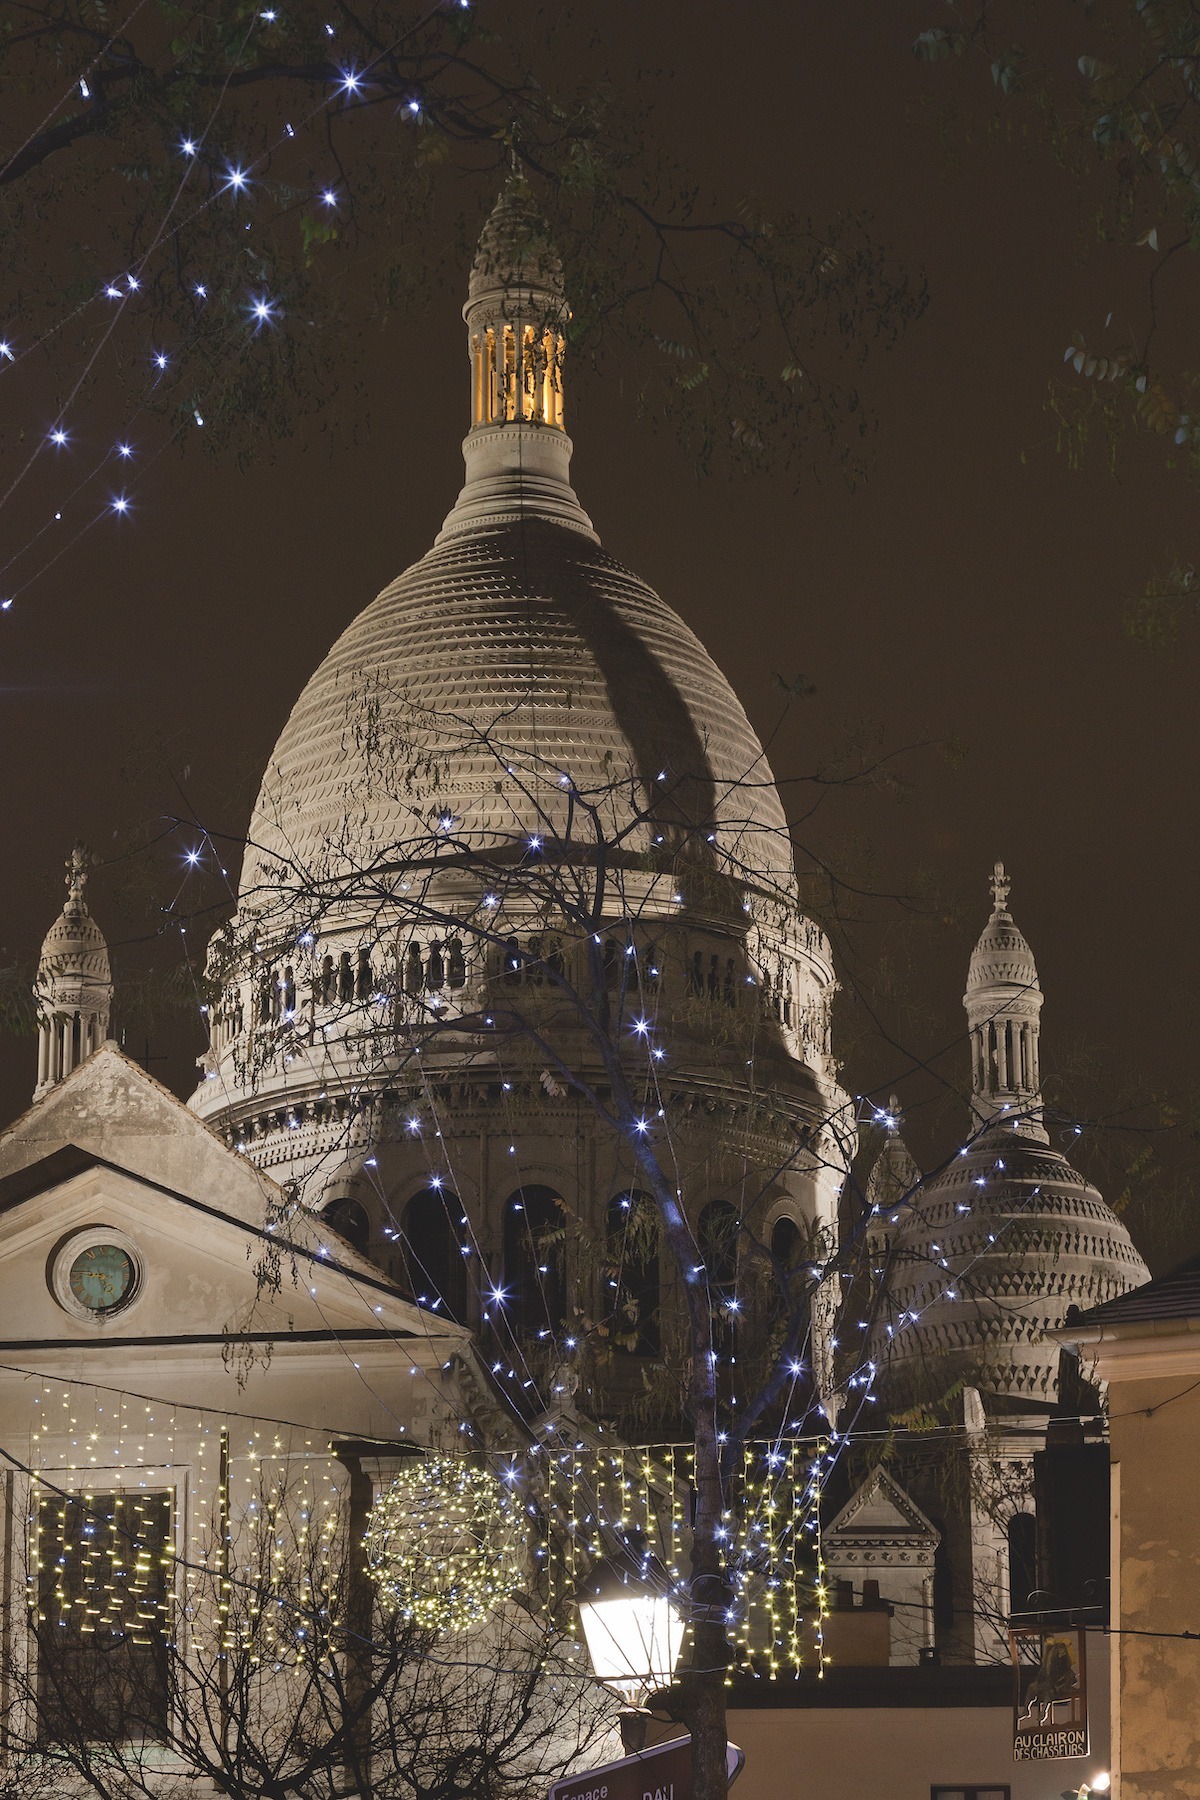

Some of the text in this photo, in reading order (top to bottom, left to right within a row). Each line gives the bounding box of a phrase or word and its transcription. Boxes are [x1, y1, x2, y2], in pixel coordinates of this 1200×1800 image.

[1014, 1730, 1085, 1748] AU CLAIRON
[1013, 1743, 1085, 1761] DES CHASSEURS
[561, 1785, 609, 1800] ace
